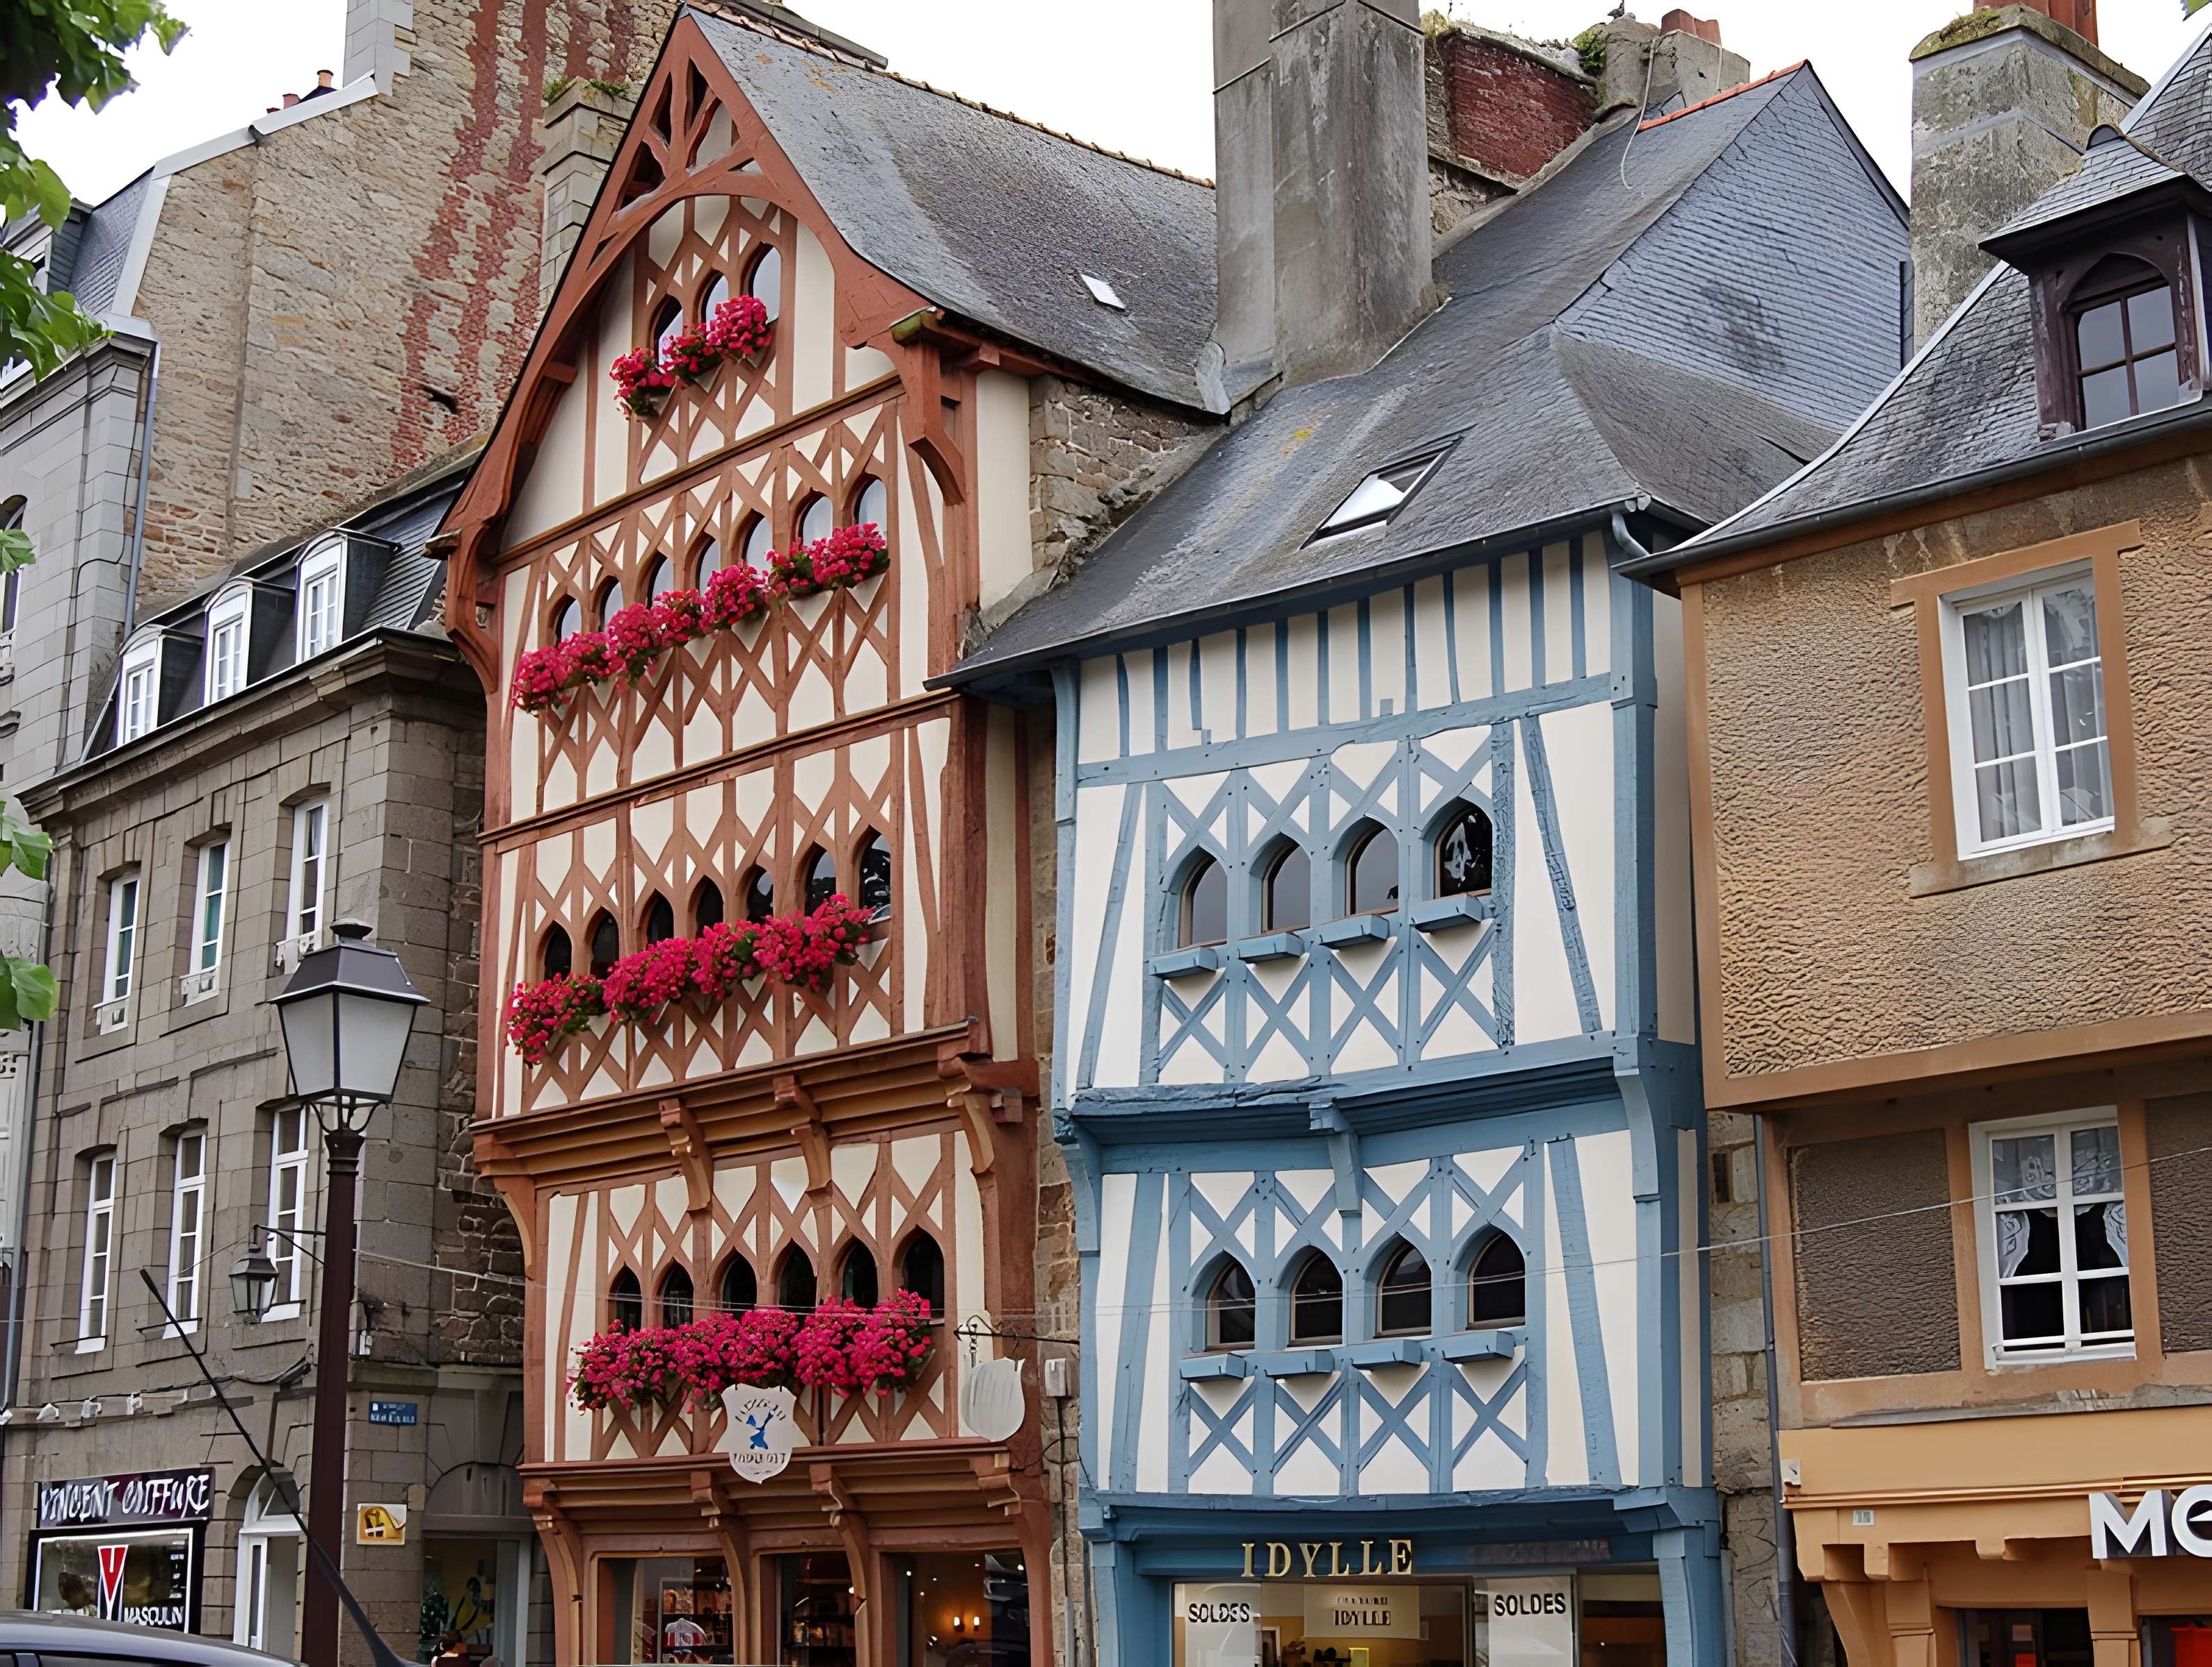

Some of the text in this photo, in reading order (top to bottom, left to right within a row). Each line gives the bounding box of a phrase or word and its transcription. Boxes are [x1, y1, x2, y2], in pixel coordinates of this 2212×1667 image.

[1240, 1539, 1412, 1577] IDYLLE
[1188, 1602, 1250, 1622] SOLDES
[1494, 1593, 1566, 1617] SOLDES
